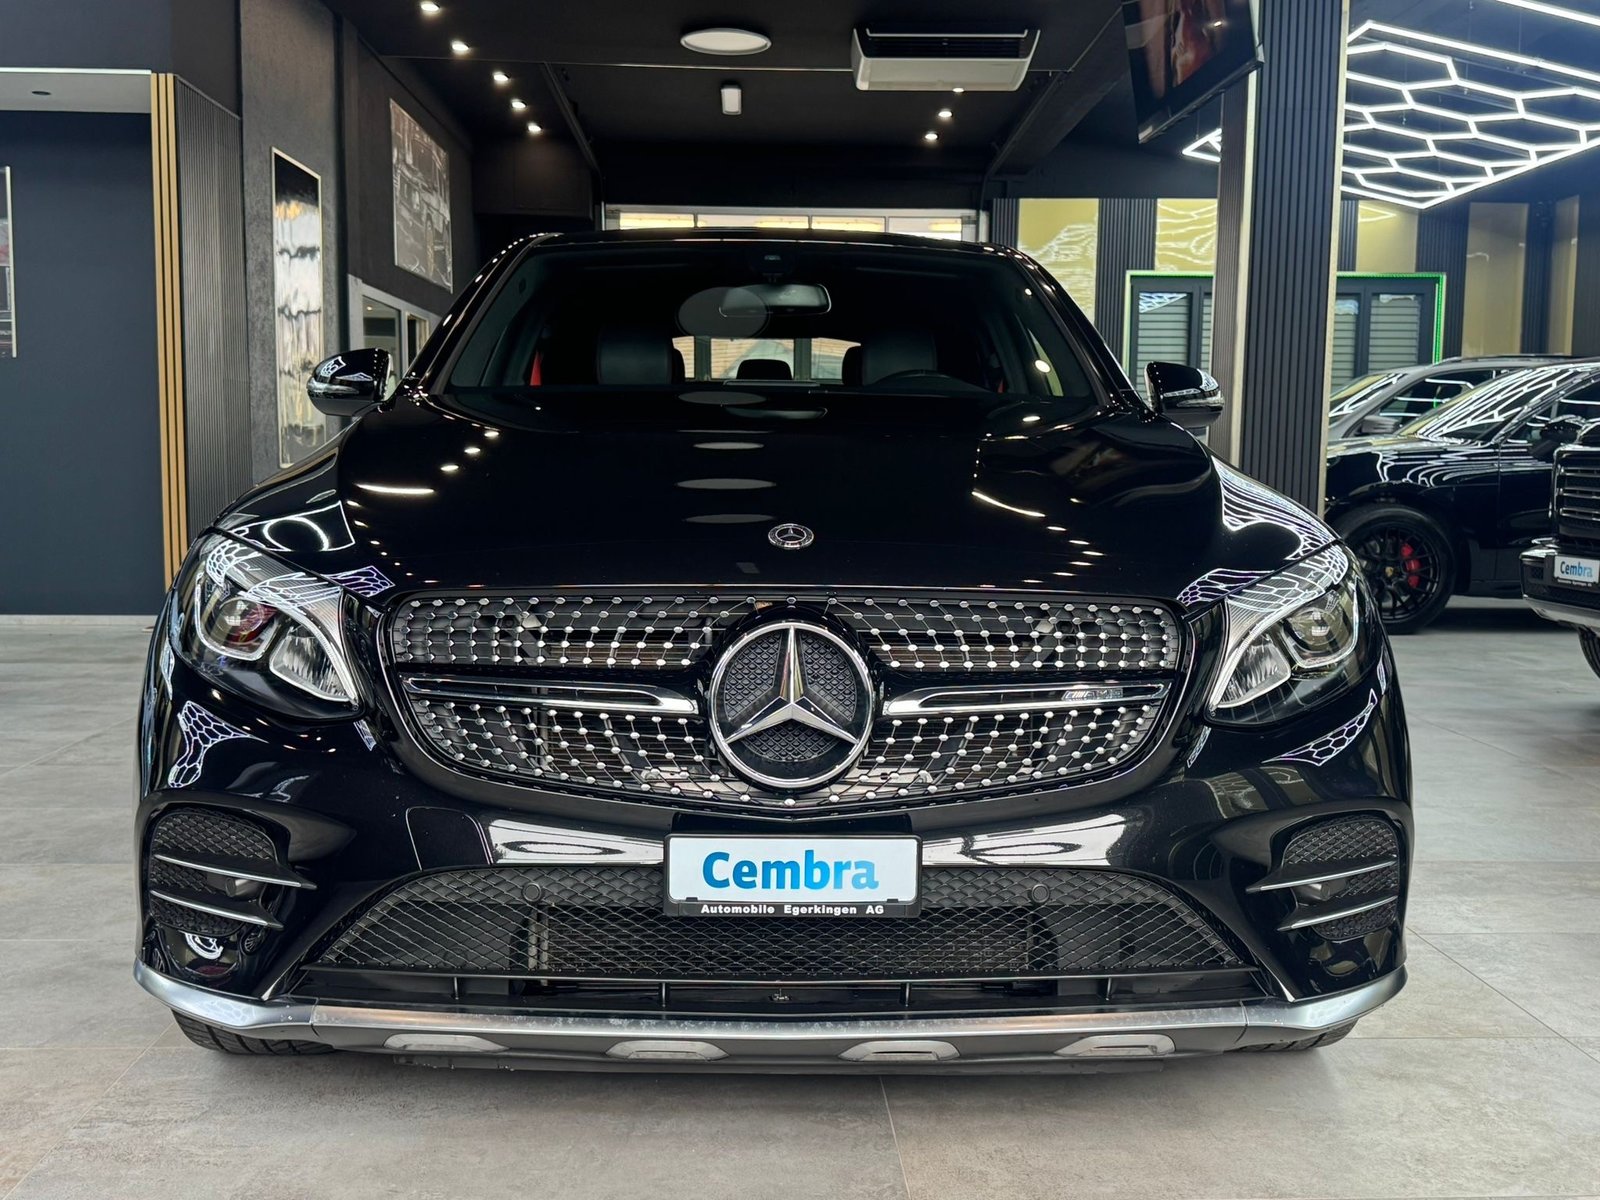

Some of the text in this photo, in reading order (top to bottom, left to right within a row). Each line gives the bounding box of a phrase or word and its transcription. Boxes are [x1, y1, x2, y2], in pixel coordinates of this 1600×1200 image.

[1560, 561, 1593, 577] Cembra
[702, 849, 879, 890] Cembra
[701, 904, 885, 916] Automobile Egerkingen AG
